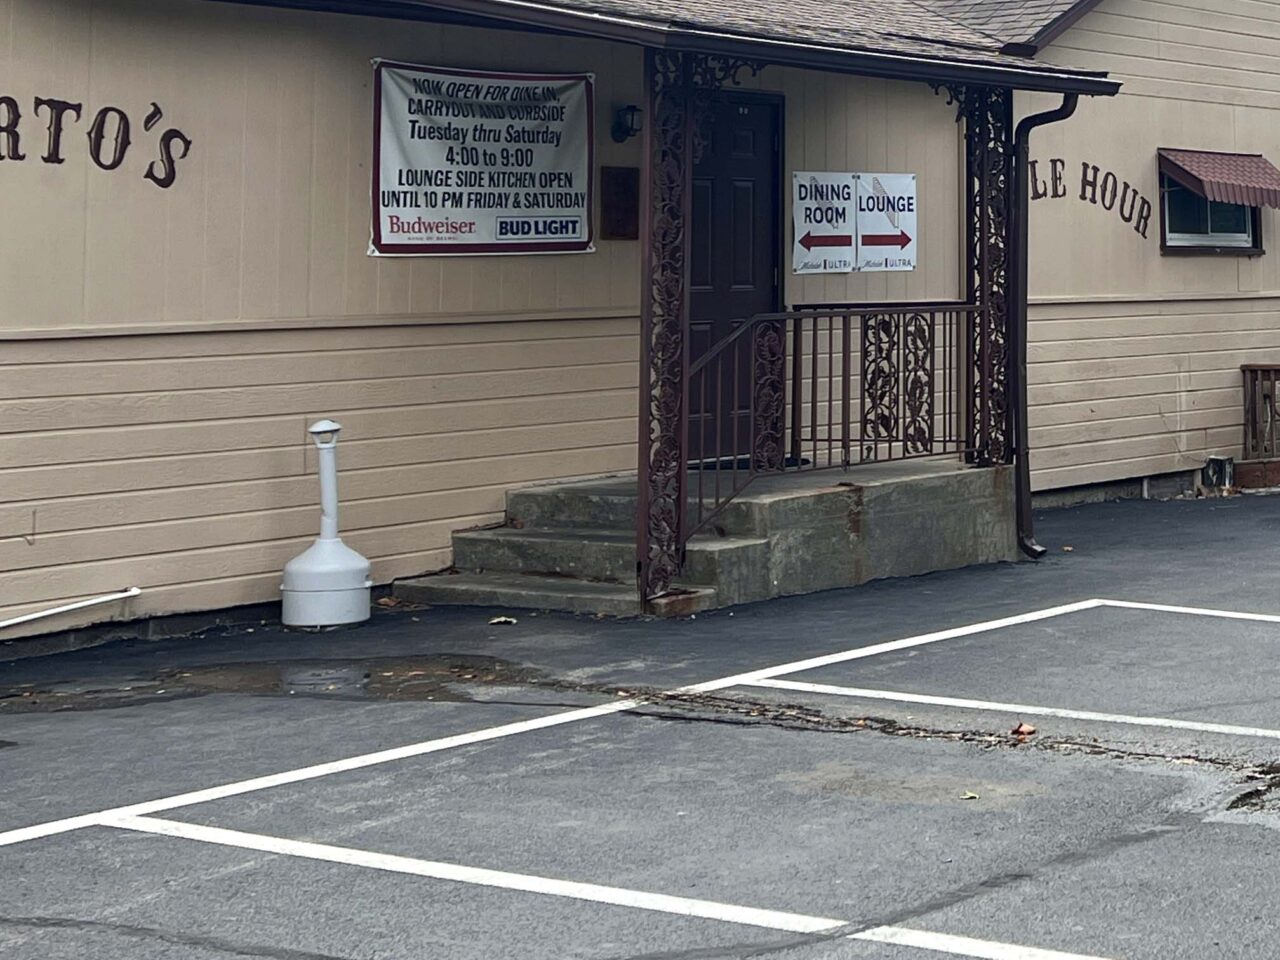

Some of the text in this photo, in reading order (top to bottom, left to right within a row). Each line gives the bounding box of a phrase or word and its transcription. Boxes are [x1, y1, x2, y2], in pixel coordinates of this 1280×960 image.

[412, 78, 445, 96] NOW
[446, 82, 484, 100] OPEN
[483, 85, 512, 102] FOR
[510, 86, 542, 102] DINE
[408, 98, 566, 122] CARRYOUT AND CURBSIDE
[408, 120, 562, 147] Tuesday thru Saturday
[445, 146, 534, 167] 4:00 to 9:00
[398, 169, 573, 189] LOUNGE SIDE KITCHEN OPEN
[381, 190, 586, 209] UNTIL 10 PM FRIDAY & SATURDAY
[798, 184, 851, 201] DINING
[1079, 161, 1152, 240] HOUR
[859, 196, 914, 212] LOUNGE
[388, 215, 476, 234] Budweiser
[804, 207, 847, 224] ROOM
[499, 220, 579, 236] BUD LIGHT
[889, 259, 912, 268] ULTRA
